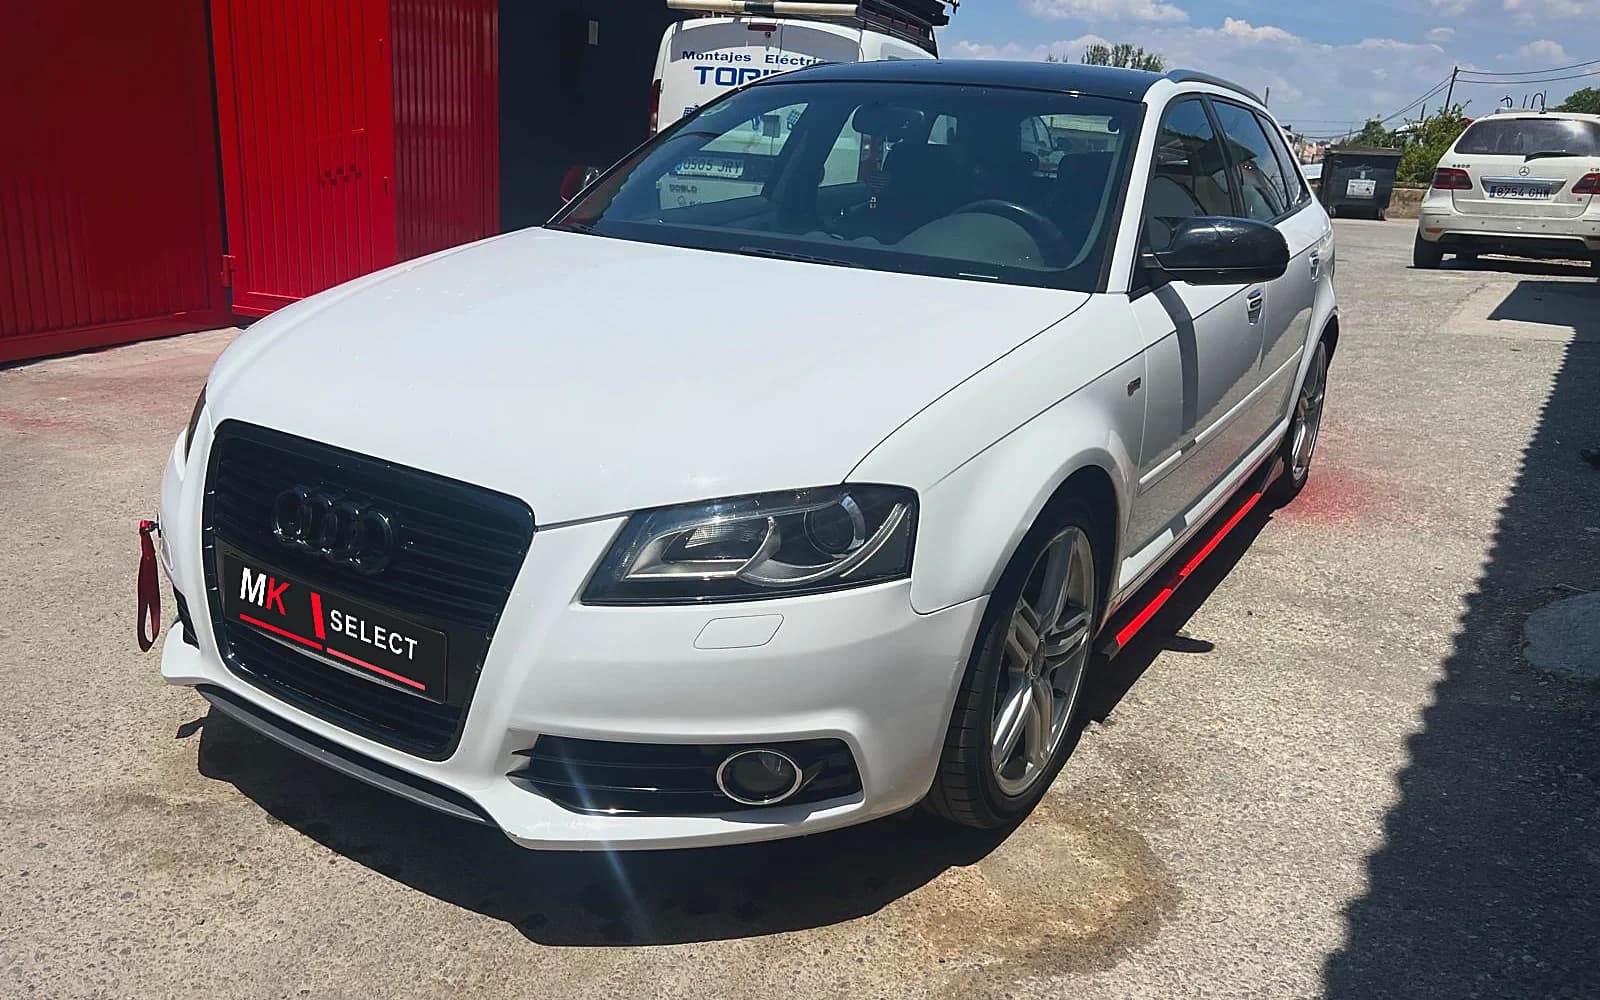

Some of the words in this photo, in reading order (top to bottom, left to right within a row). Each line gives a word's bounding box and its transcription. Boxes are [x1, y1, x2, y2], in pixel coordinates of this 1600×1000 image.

[681, 50, 752, 64] Montajes
[693, 66, 786, 87] TOR
[1496, 186, 1524, 198] 8754
[239, 567, 291, 616] MK
[329, 609, 418, 661] SELECT
